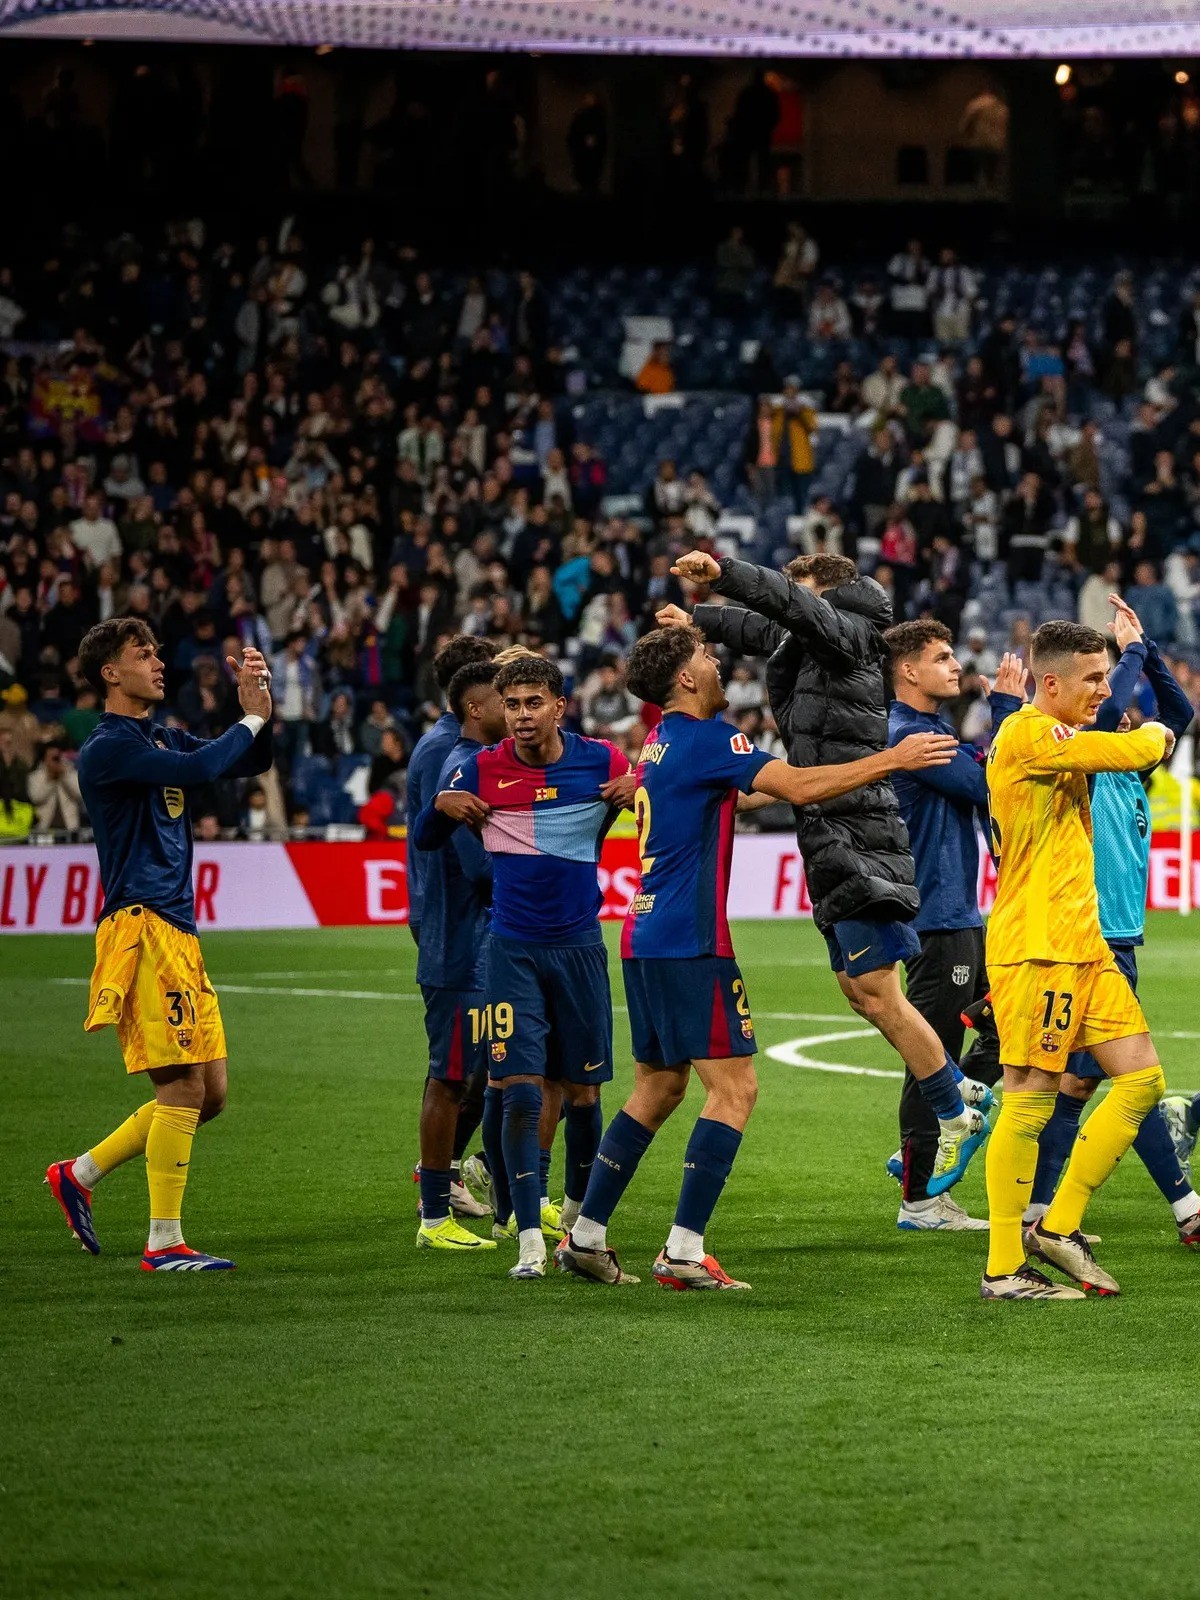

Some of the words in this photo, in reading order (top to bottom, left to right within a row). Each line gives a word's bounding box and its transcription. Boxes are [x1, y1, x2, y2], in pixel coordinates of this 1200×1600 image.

[165, 990, 197, 1026] 31
[732, 978, 749, 1016] 2
[1042, 990, 1073, 1030] 13
[485, 1002, 514, 1040] 19
